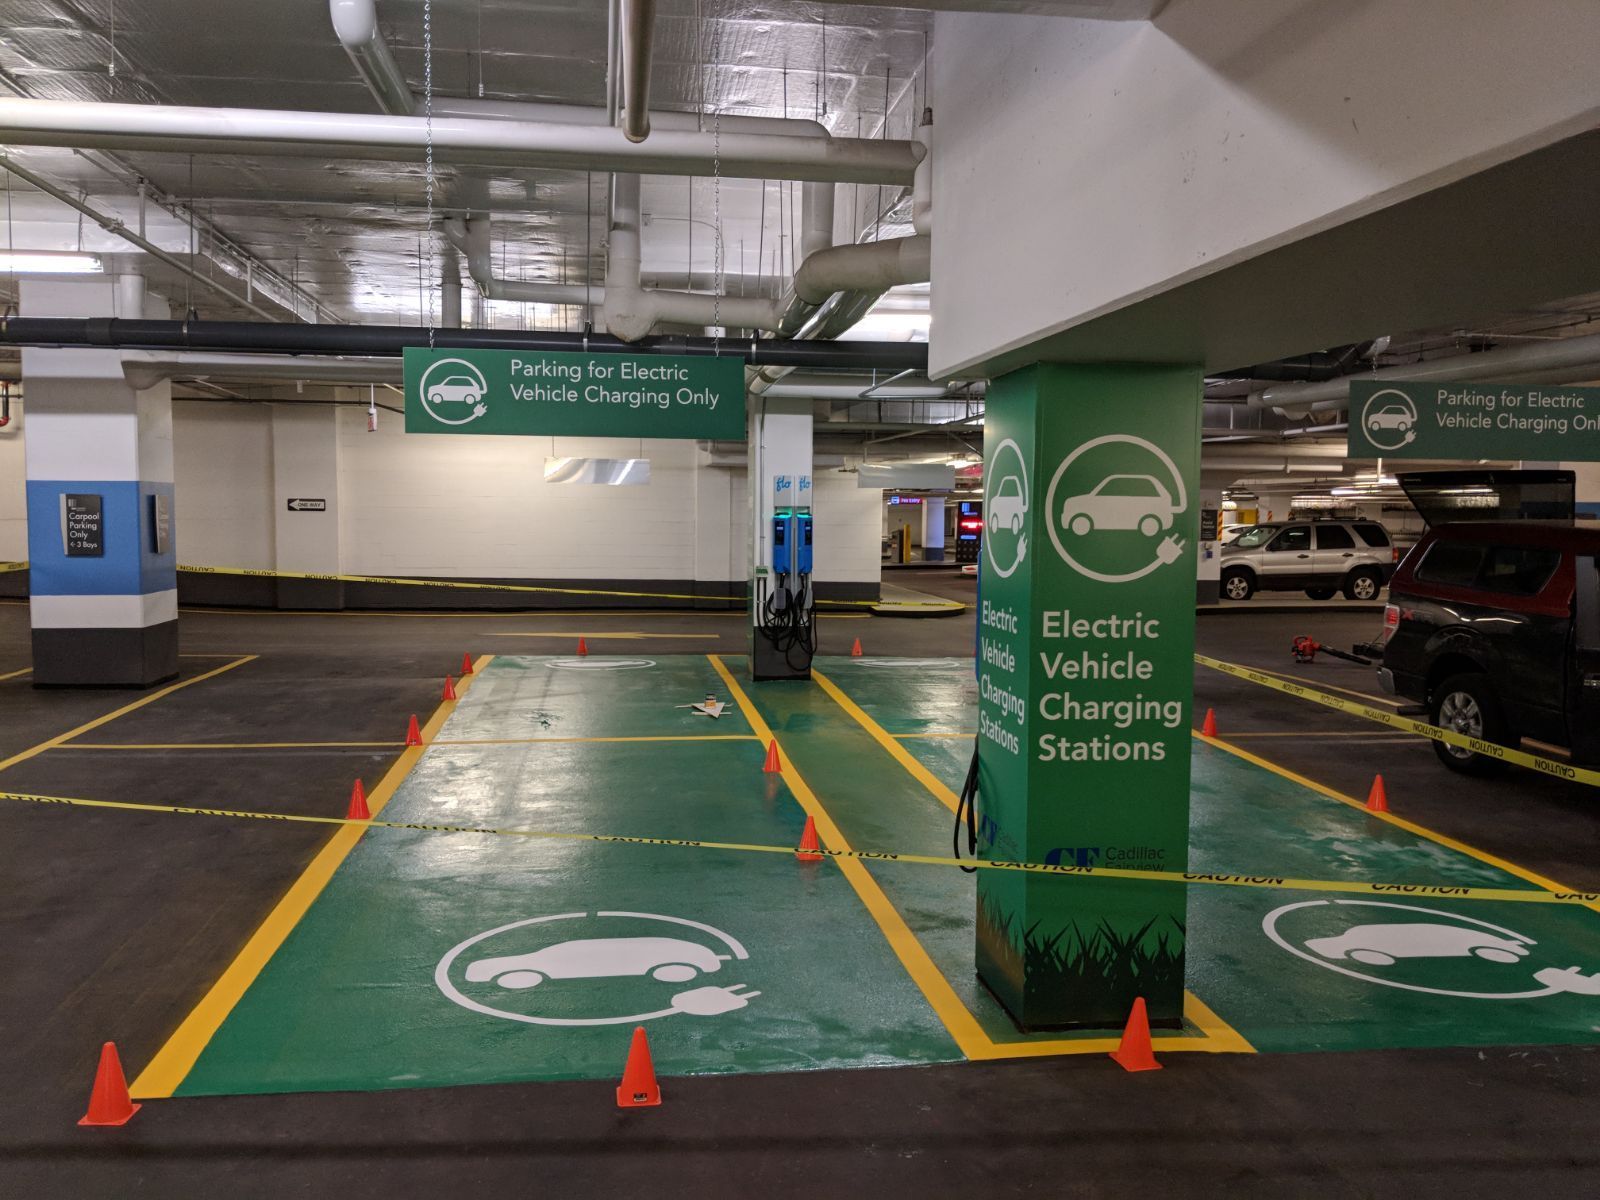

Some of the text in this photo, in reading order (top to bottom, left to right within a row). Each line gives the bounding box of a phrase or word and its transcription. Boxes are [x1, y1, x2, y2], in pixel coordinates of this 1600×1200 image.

[511, 359, 689, 383] Parking for Electric
[510, 383, 720, 410] Vehicle Charging Only
[1437, 389, 1585, 411] Parking for Electric
[1436, 412, 1492, 429] Vehicle
[1496, 413, 1568, 434] Charging
[69, 512, 100, 521] Carpool
[69, 521, 98, 531] Parking
[69, 530, 88, 540] Only
[180, 565, 215, 573] CAUTION
[982, 600, 1018, 635] Electric
[1041, 609, 1160, 639] Electric
[981, 636, 1016, 673] Vehicle
[1039, 651, 1154, 680] Vehicle
[980, 673, 1025, 726] Charging
[1038, 691, 1182, 729] Charging
[1362, 708, 1391, 723] CAUTION
[980, 709, 1019, 755] Stations
[1412, 722, 1443, 739] CAUTION
[1037, 733, 1167, 762] Stations
[1469, 739, 1504, 757] CAUTION
[1534, 758, 1576, 778] CAUTION
[1105, 846, 1166, 861] Cadillac
[1183, 873, 1284, 885] CAUTION
[1371, 883, 1471, 895] CAUTION
